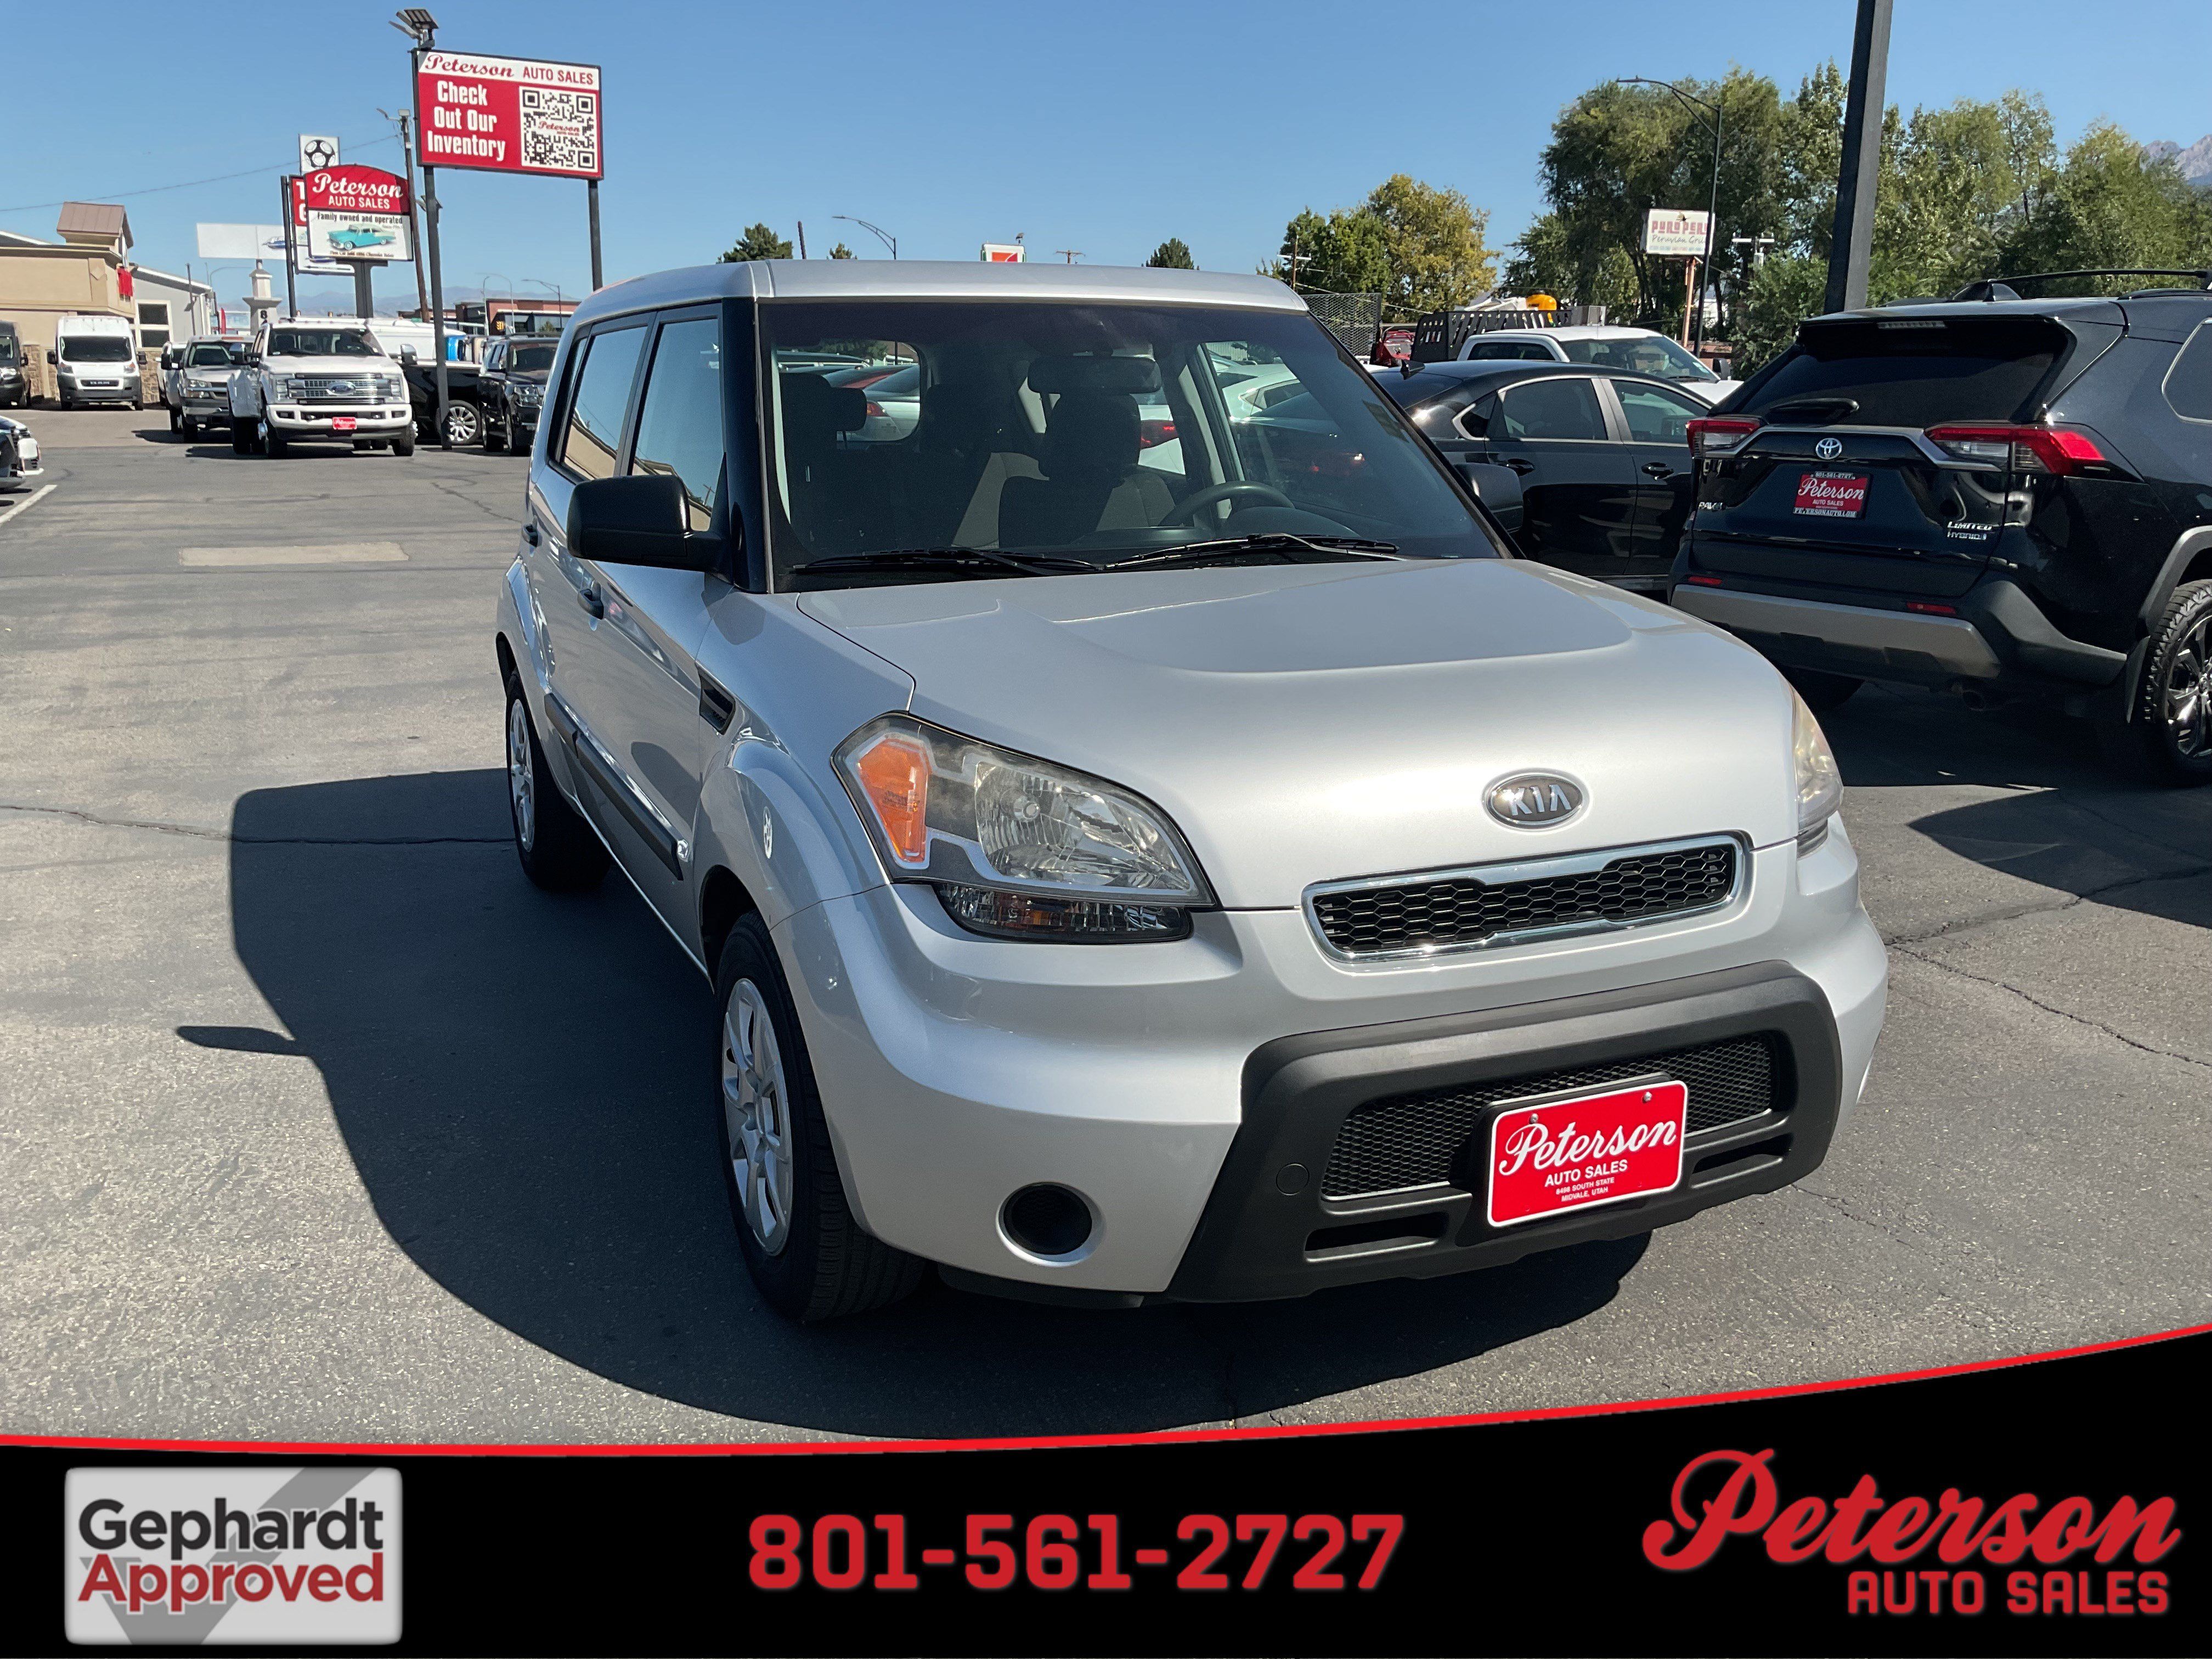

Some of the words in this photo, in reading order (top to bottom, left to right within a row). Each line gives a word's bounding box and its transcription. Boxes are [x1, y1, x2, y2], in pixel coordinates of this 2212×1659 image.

[425, 54, 514, 77] Peterson
[523, 66, 554, 81] AUTO
[557, 70, 593, 85] SALES
[437, 80, 488, 106] Check
[433, 106, 462, 129] Out
[467, 109, 497, 132] Our
[427, 130, 506, 162] Inventory
[312, 173, 403, 199] Peterson
[328, 195, 356, 207] AUTO
[358, 197, 390, 210] SALES
[317, 212, 337, 222] Family
[375, 215, 403, 224] operated
[1798, 477, 1864, 500] Peterson
[1501, 784, 1572, 816] KIA
[1499, 1120, 1677, 1176] Peterson
[1544, 1169, 1581, 1187] AUTO
[1584, 1159, 1628, 1178] SALES
[1572, 1181, 1594, 1192] SOUTH
[1595, 1177, 1615, 1186] STATE
[1592, 1186, 1608, 1195] UTAH
